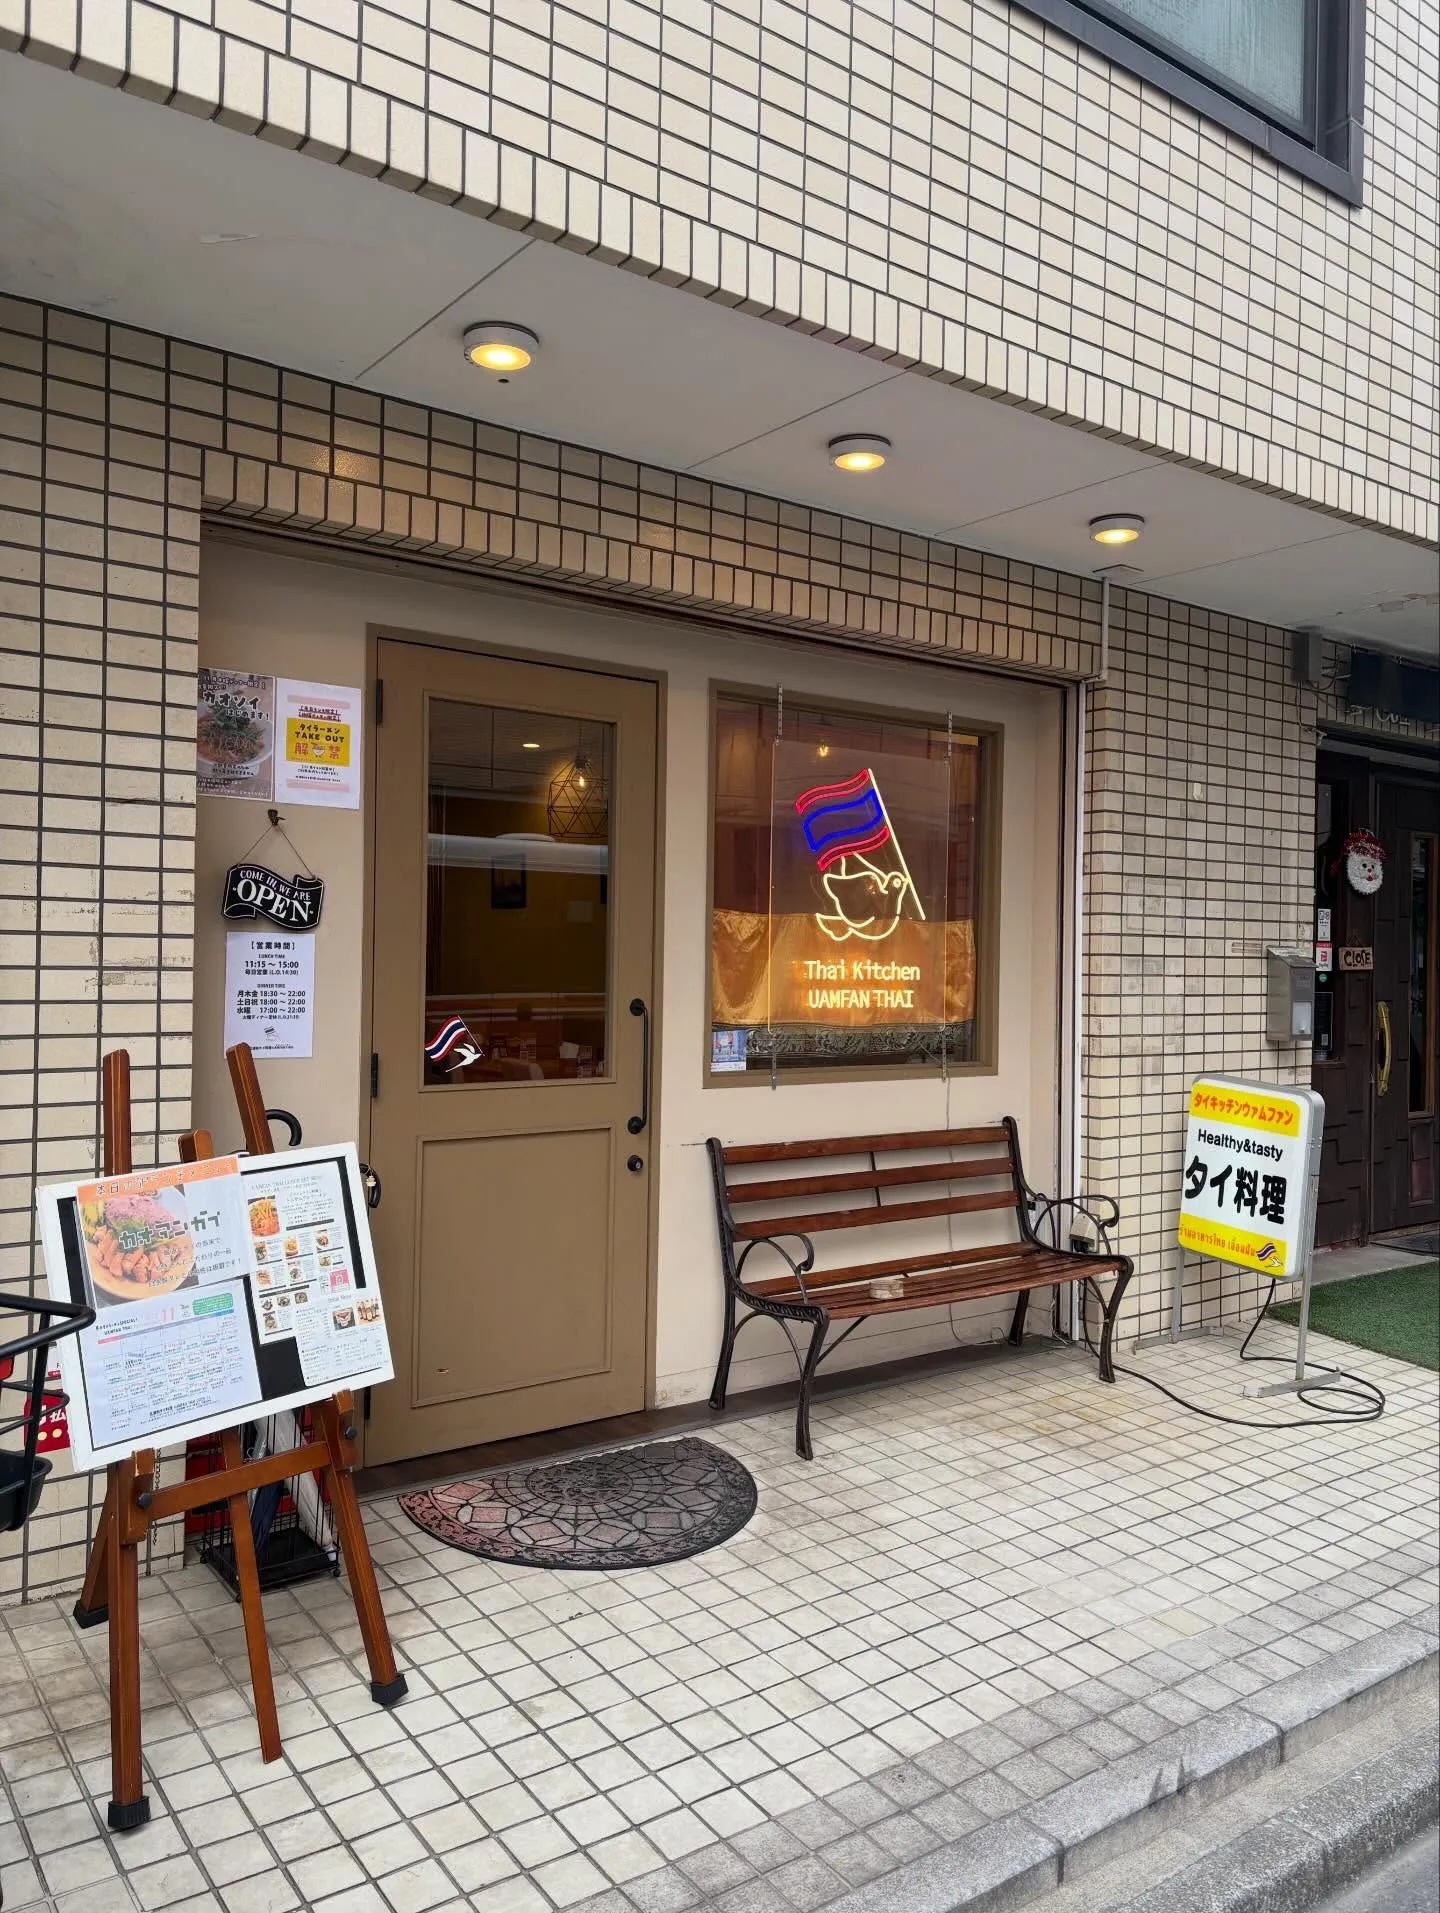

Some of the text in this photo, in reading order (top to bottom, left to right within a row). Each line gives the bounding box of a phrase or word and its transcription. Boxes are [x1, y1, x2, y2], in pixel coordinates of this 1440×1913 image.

[203, 690, 261, 711] カオソイ
[295, 731, 345, 743] TAKE OUT
[300, 723, 341, 735] タイラーメン
[240, 870, 265, 881] COME
[279, 883, 292, 897] WE
[293, 888, 312, 901] ARE
[237, 878, 312, 922] OPEN
[245, 960, 267, 968] 11:15
[804, 959, 921, 981] Thai Kitchen
[236, 998, 259, 1006] 土日祝
[237, 990, 259, 998] 月木金
[808, 989, 914, 1009] UAMFAN THAI
[236, 1006, 251, 1014] 水曜
[1194, 1092, 1294, 1125] タイキッチンウァムファン
[1198, 1128, 1283, 1162] Healthy&tasty
[1184, 1154, 1288, 1225] タイ料理
[119, 1210, 220, 1250] カオマンガイ
